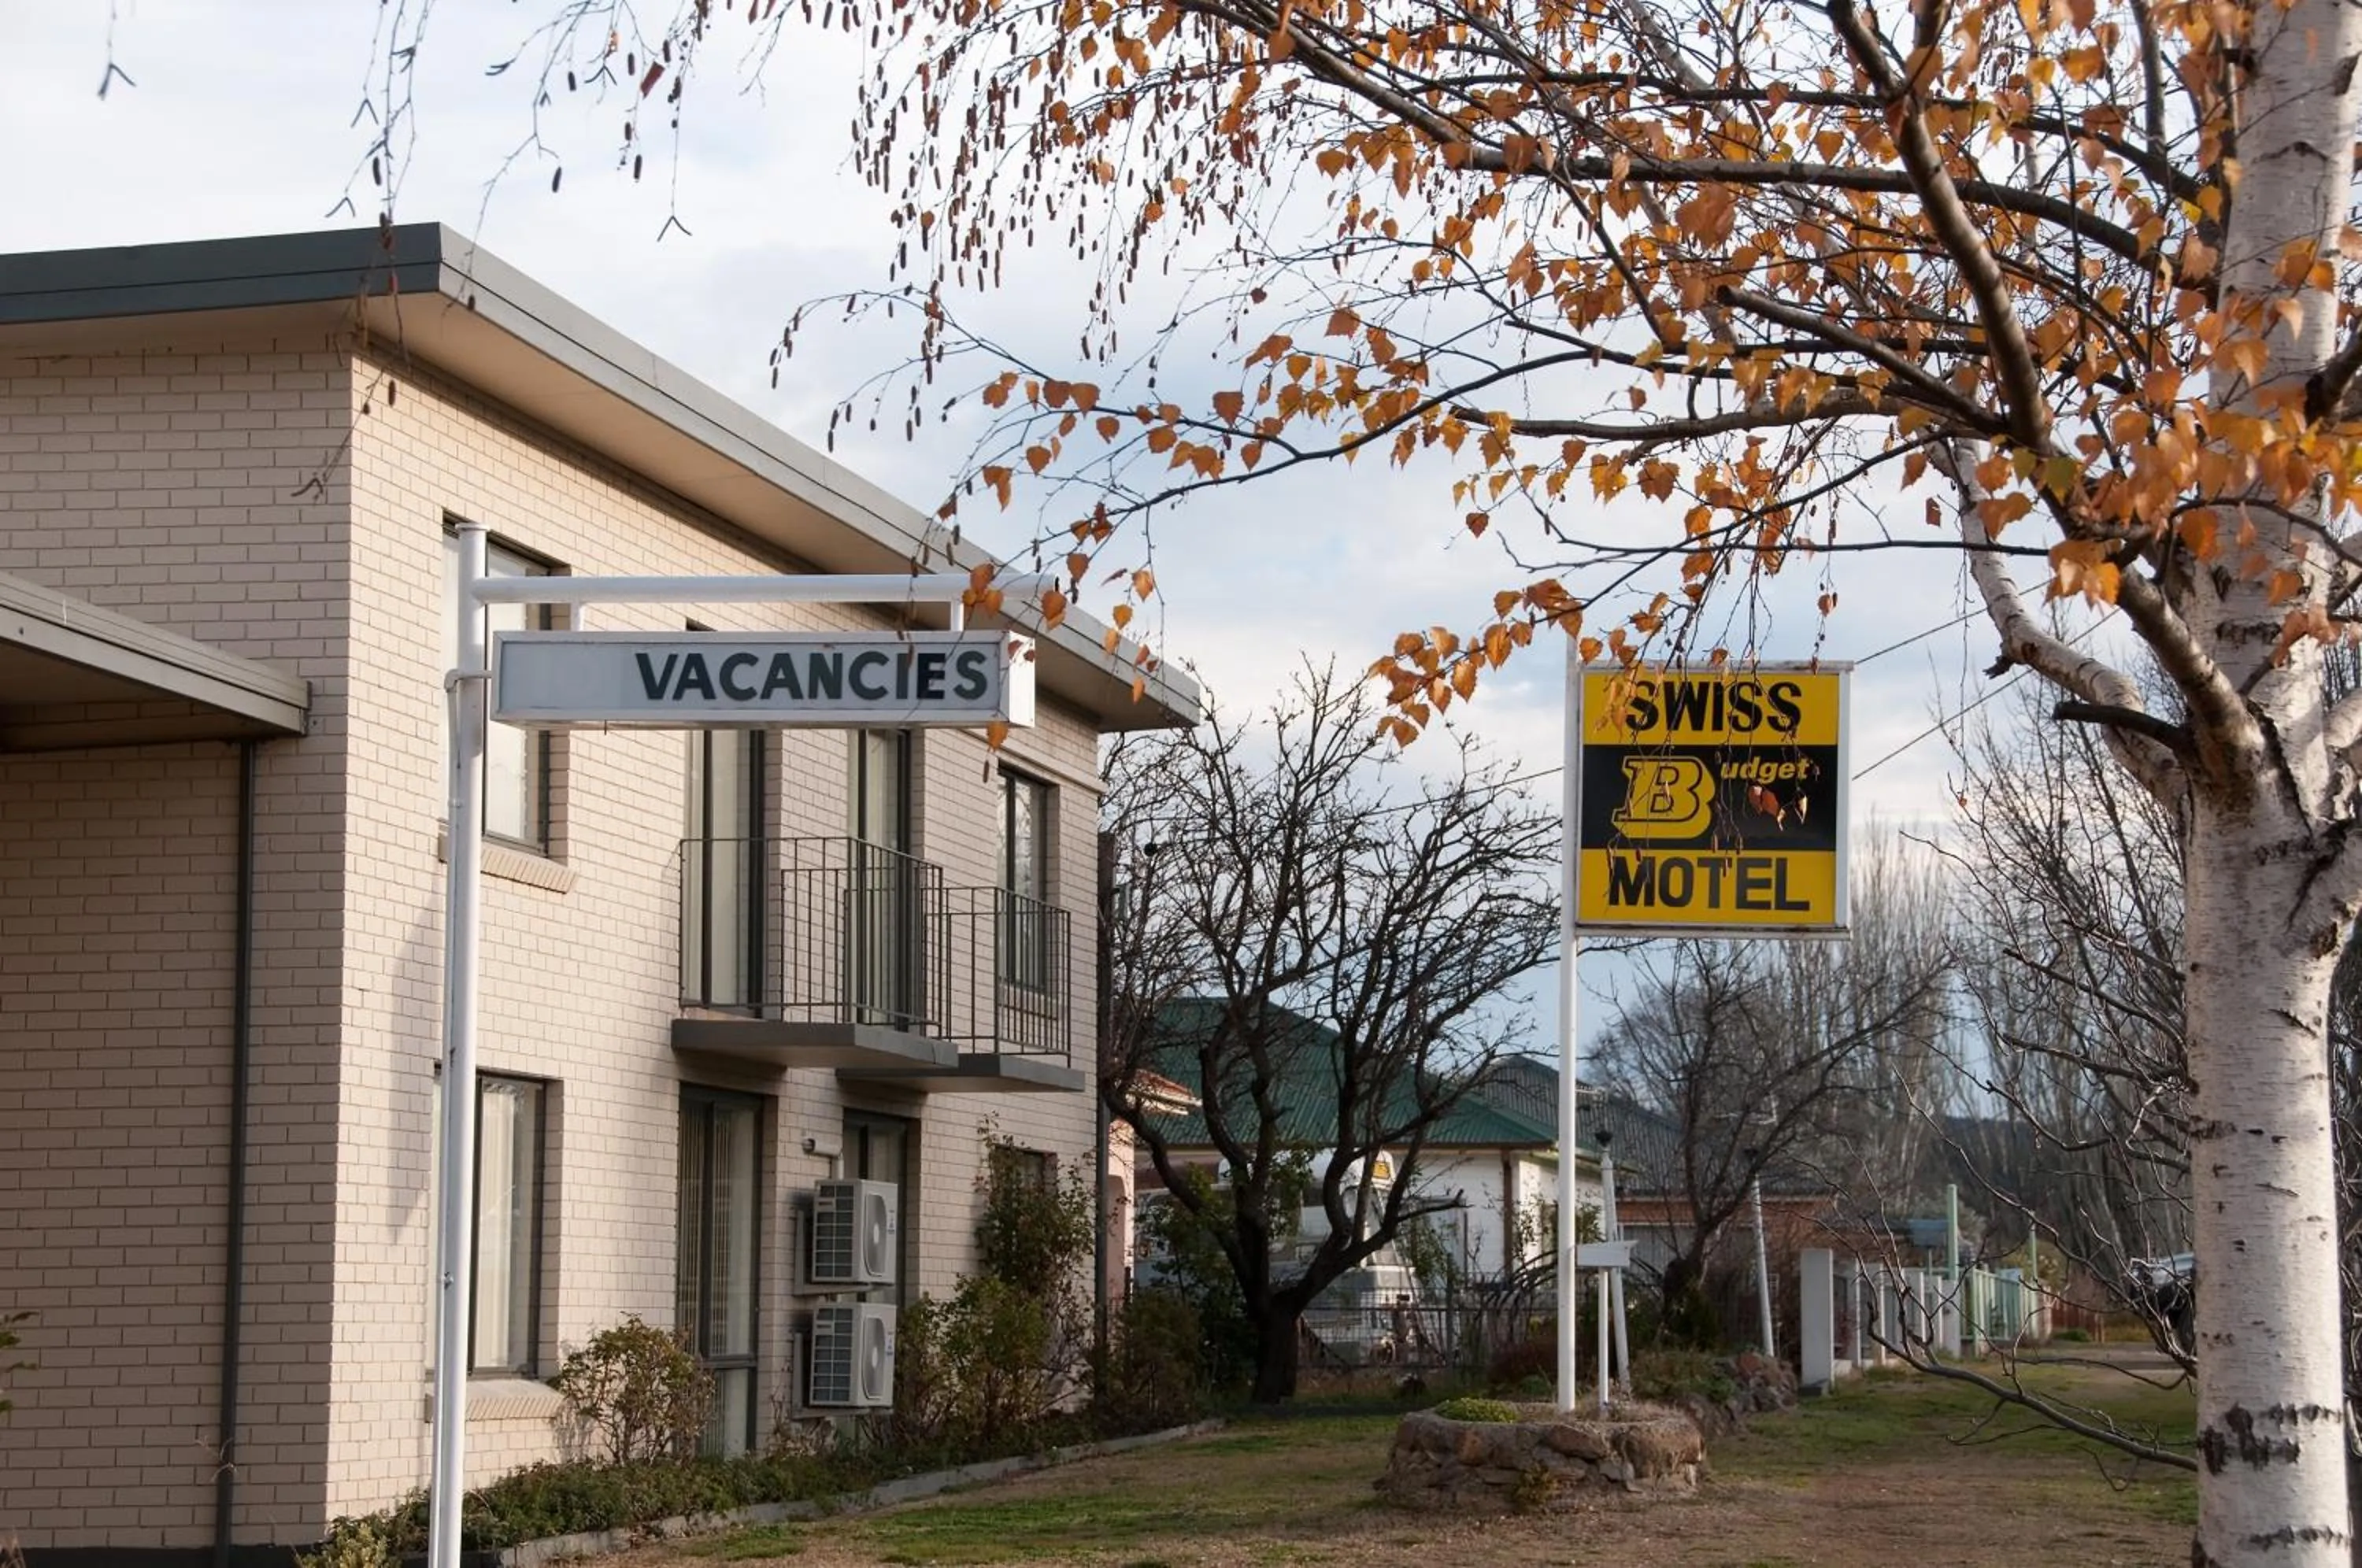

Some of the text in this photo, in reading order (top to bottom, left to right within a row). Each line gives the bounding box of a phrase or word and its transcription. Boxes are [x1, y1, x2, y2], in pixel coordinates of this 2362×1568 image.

[635, 652, 988, 701] VACANCIES
[1626, 680, 1801, 732] SWISS
[1612, 756, 1811, 839] Budget
[1609, 856, 1810, 911] MOTEL
